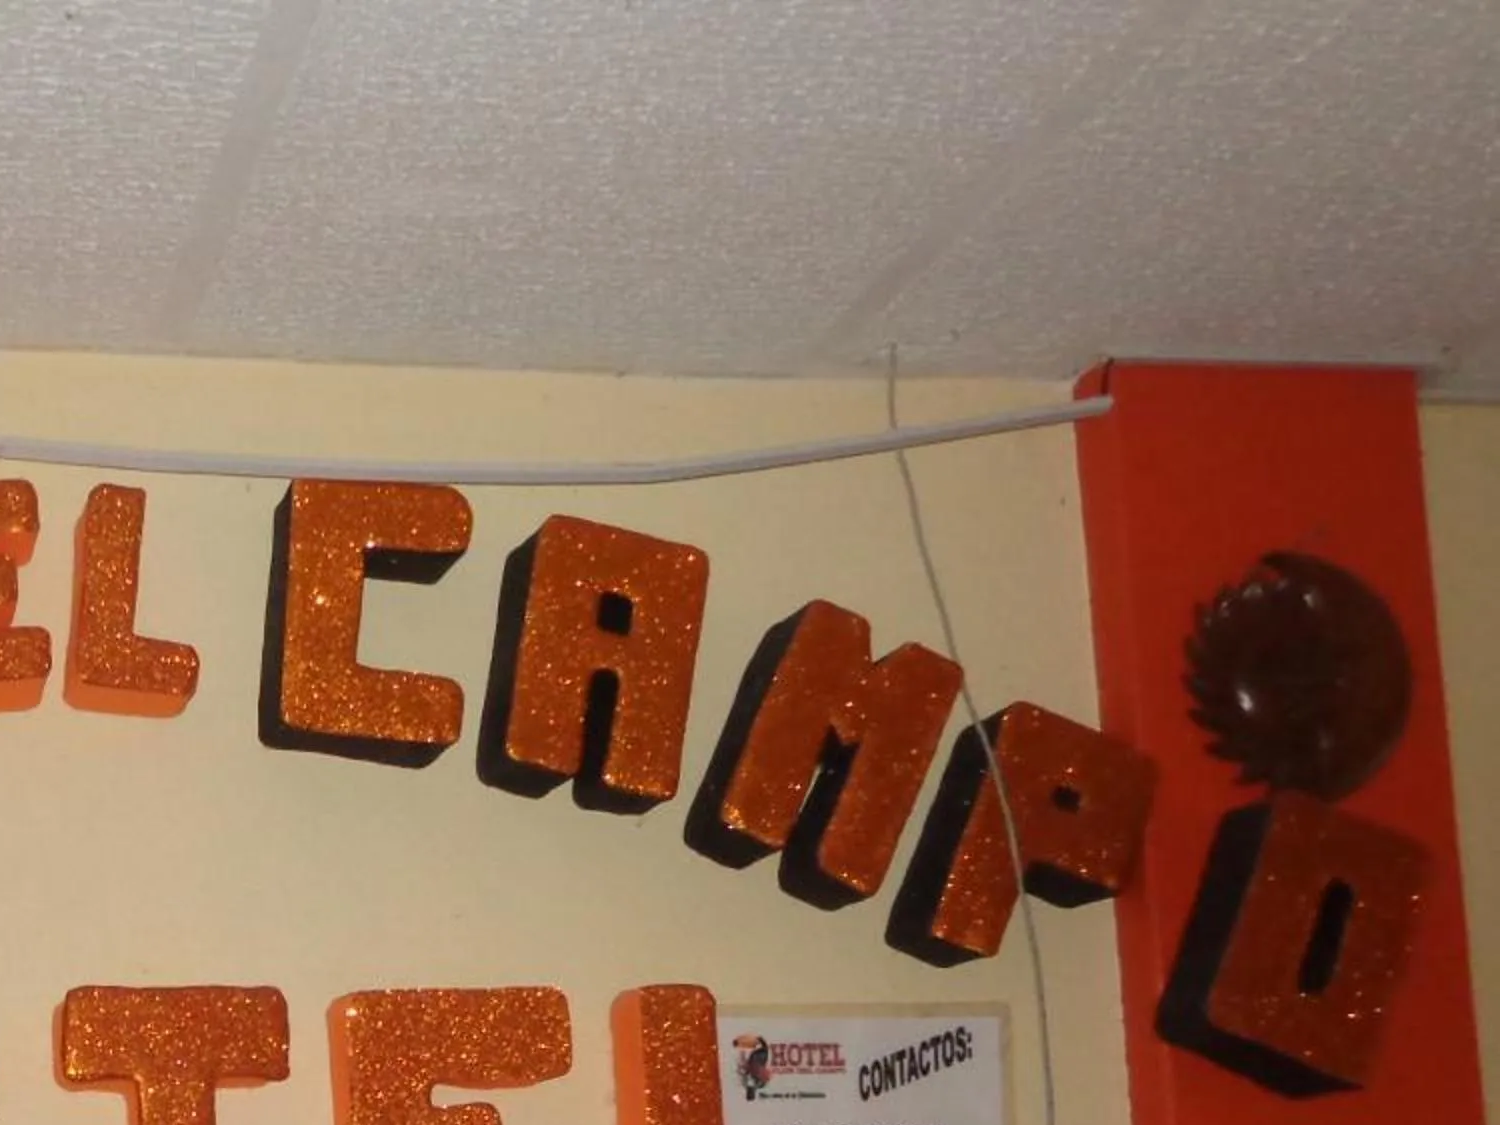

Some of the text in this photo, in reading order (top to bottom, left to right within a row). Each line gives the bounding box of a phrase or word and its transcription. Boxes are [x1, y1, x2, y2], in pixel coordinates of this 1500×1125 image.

[260, 478, 1435, 1098] CAMPO
[770, 1043, 846, 1067] HOTEL
[858, 1026, 974, 1101] CONTACTOS:
